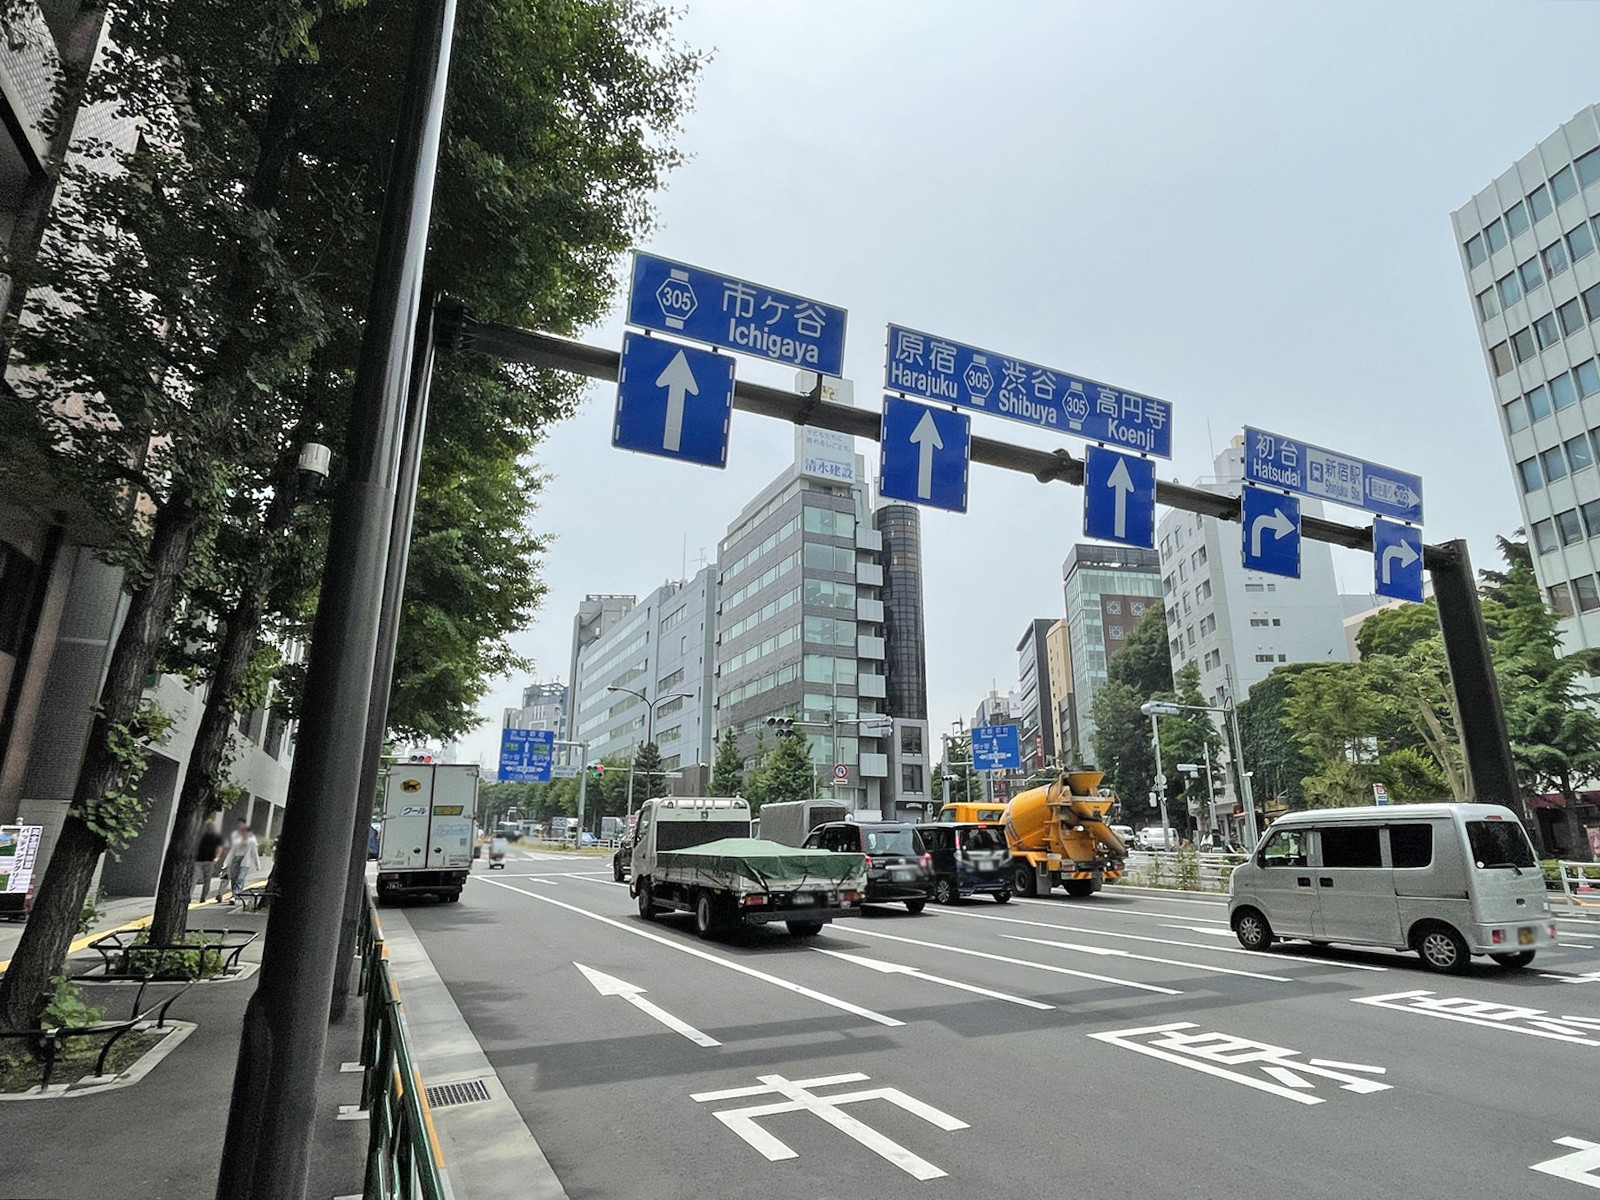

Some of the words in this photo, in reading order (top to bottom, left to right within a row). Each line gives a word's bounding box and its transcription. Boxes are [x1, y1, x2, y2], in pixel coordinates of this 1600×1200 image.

[662, 287, 691, 312] 305
[728, 318, 819, 364] Ichigaya
[896, 331, 957, 374] 原宿
[891, 362, 958, 399] Harajuku
[968, 371, 990, 390] 305
[1001, 360, 1056, 400] 渋谷
[998, 389, 1057, 425] Shibuya
[1066, 400, 1086, 416] 305
[1096, 387, 1167, 430] 高円寺
[1108, 418, 1155, 451] Koenji
[1256, 433, 1299, 467] 初台
[805, 458, 853, 479] 清水建設
[1253, 458, 1300, 487] Hatsudai
[1325, 458, 1361, 485] 新宿駅
[689, 1072, 971, 1181] 市
